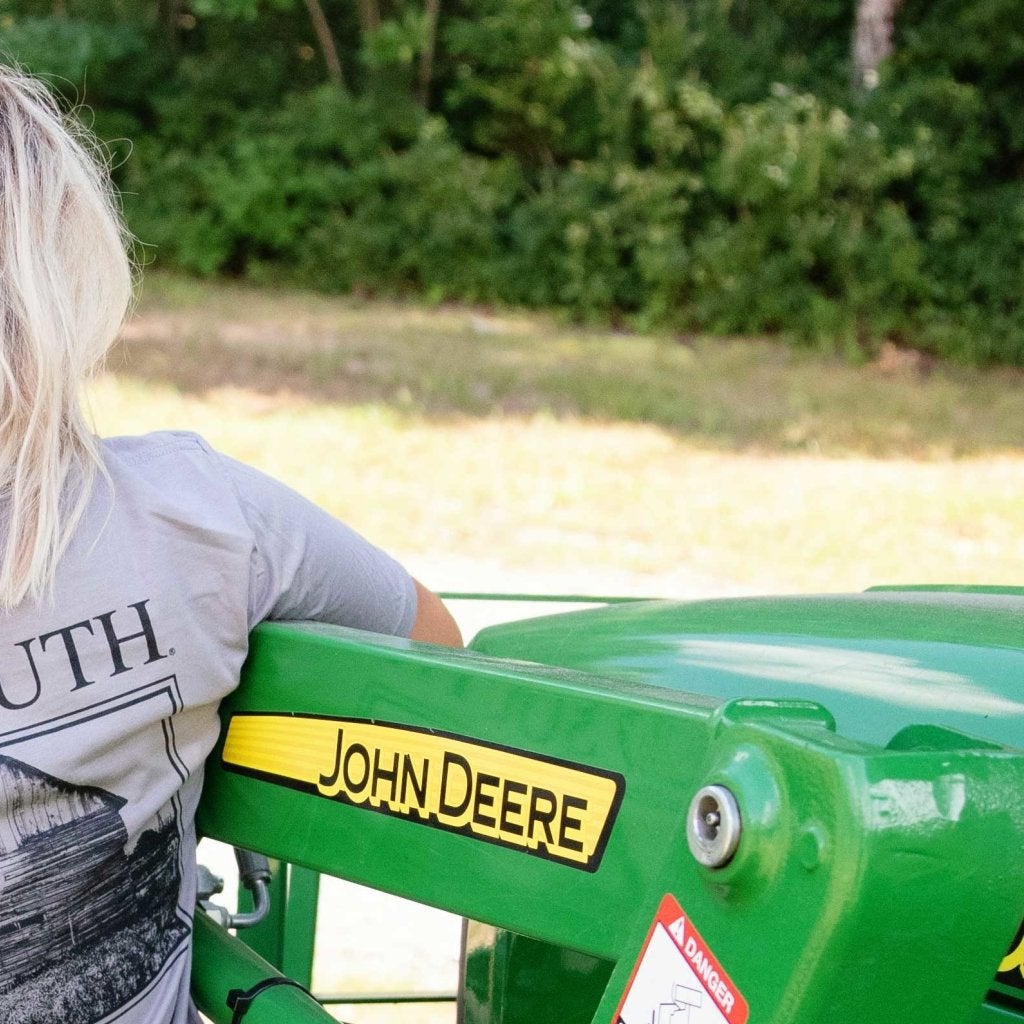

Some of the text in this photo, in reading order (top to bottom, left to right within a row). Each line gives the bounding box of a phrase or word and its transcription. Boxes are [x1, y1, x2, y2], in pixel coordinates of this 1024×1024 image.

[318, 728, 588, 852] JOHN DEERE
[684, 936, 735, 1014] DANGER
